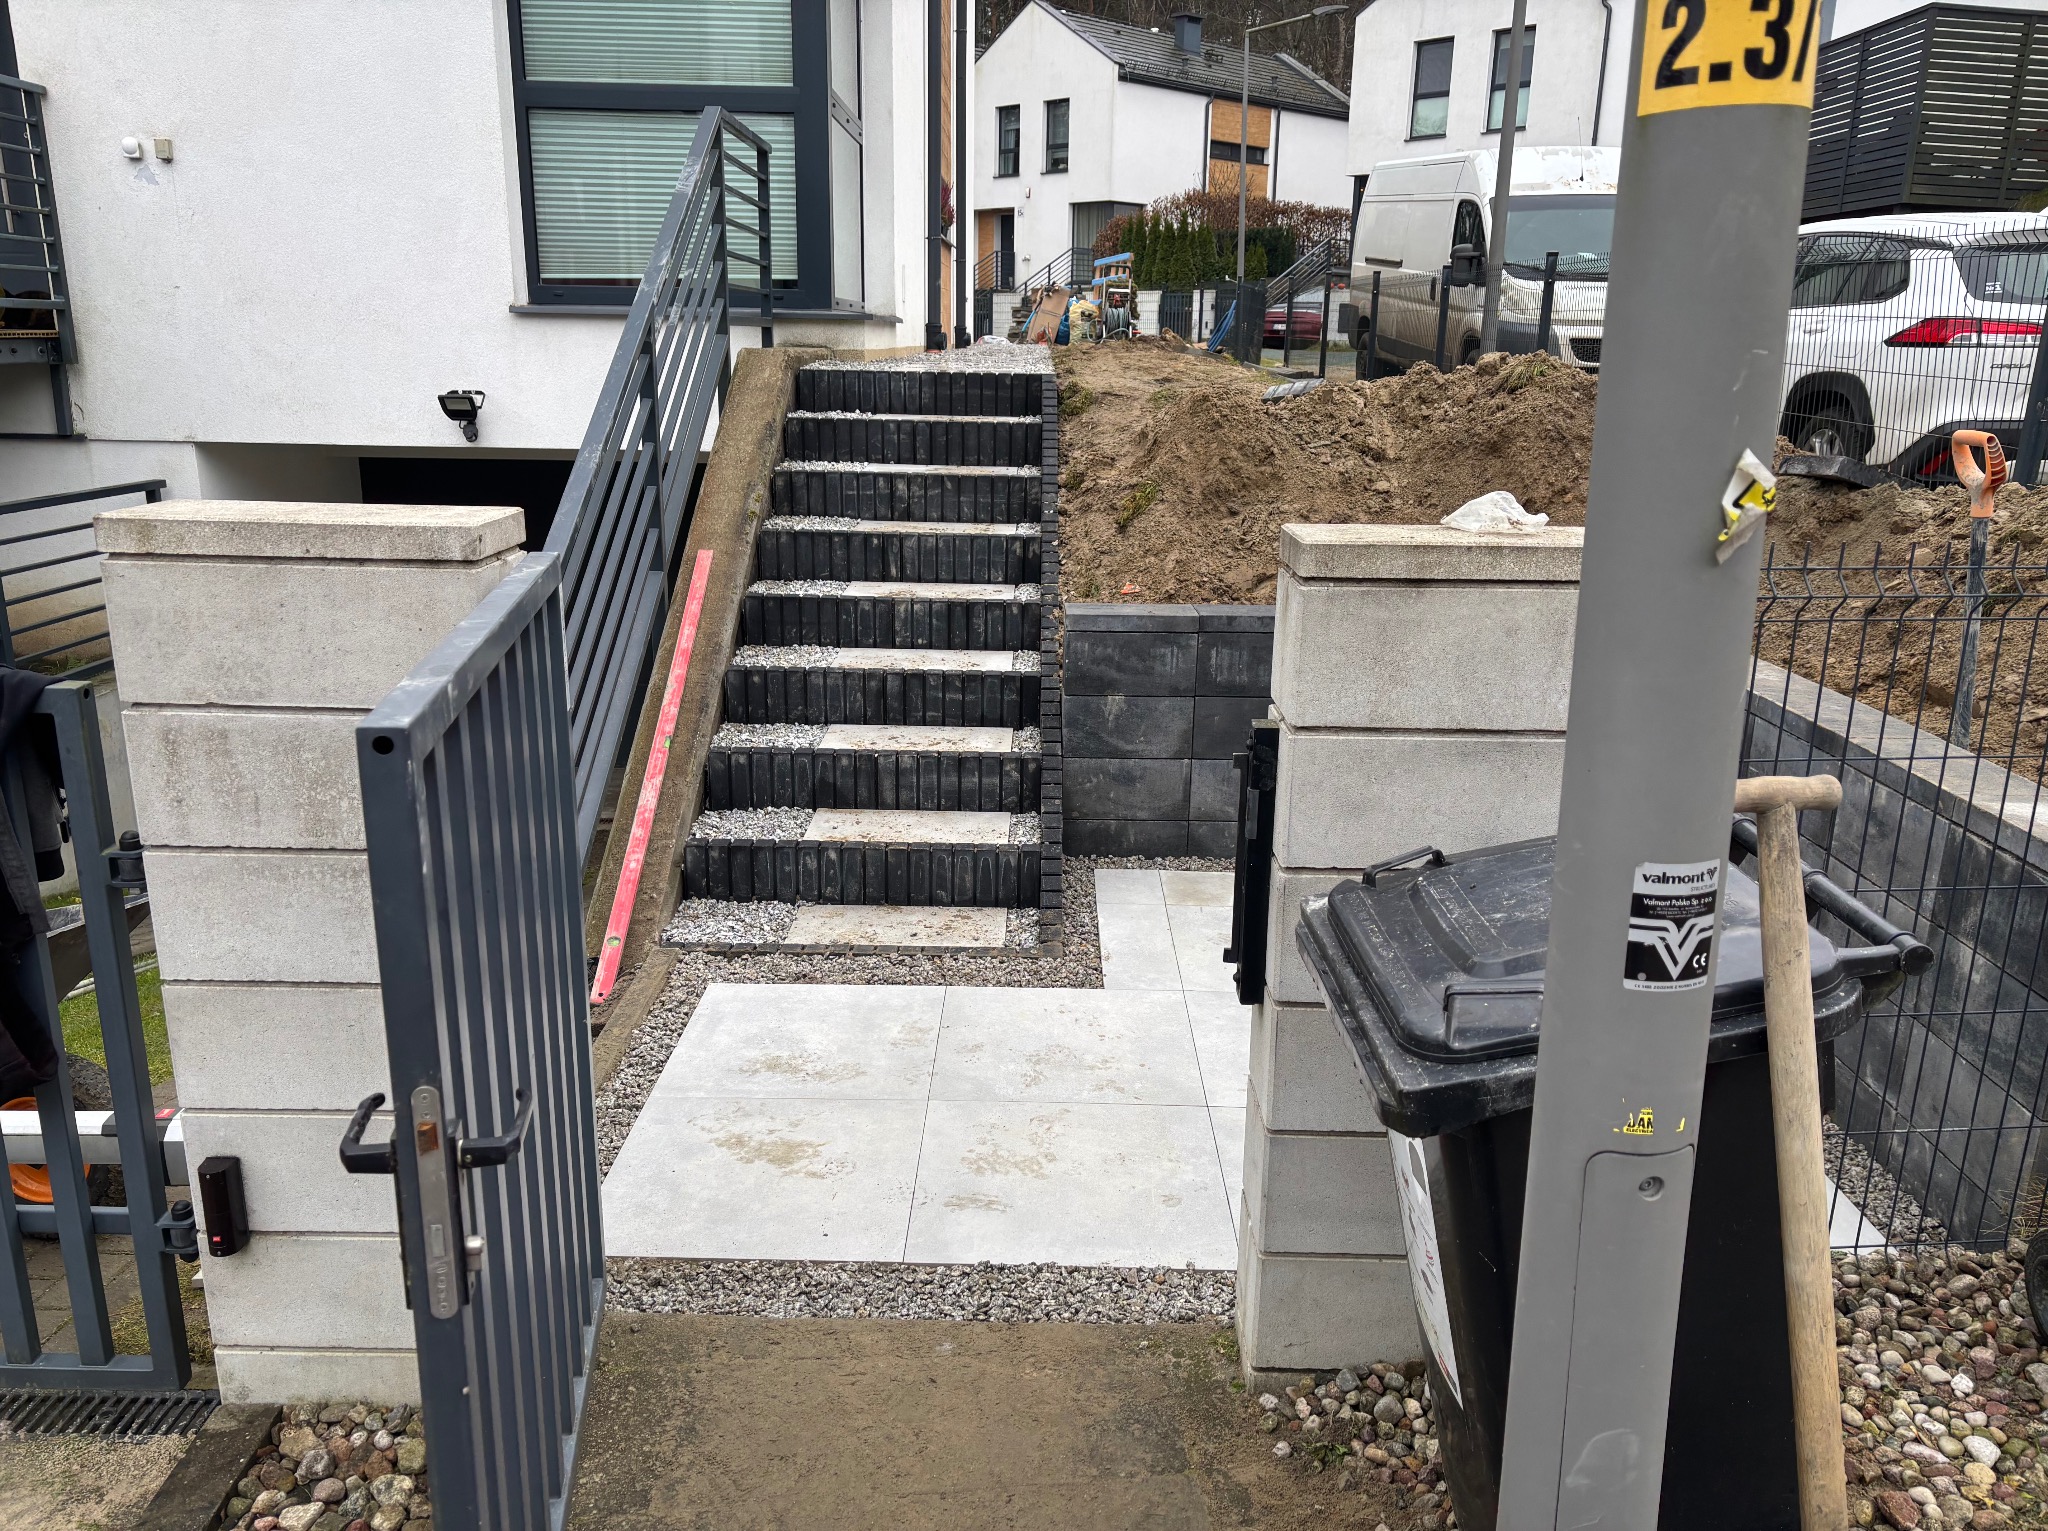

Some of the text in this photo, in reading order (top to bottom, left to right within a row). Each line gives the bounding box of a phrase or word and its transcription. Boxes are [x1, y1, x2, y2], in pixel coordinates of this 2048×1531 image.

[1642, 871, 1706, 885] valmont
[1643, 897, 1671, 906] Valmont
[1671, 898, 1691, 906] Polska
[1692, 952, 1708, 968] CE
